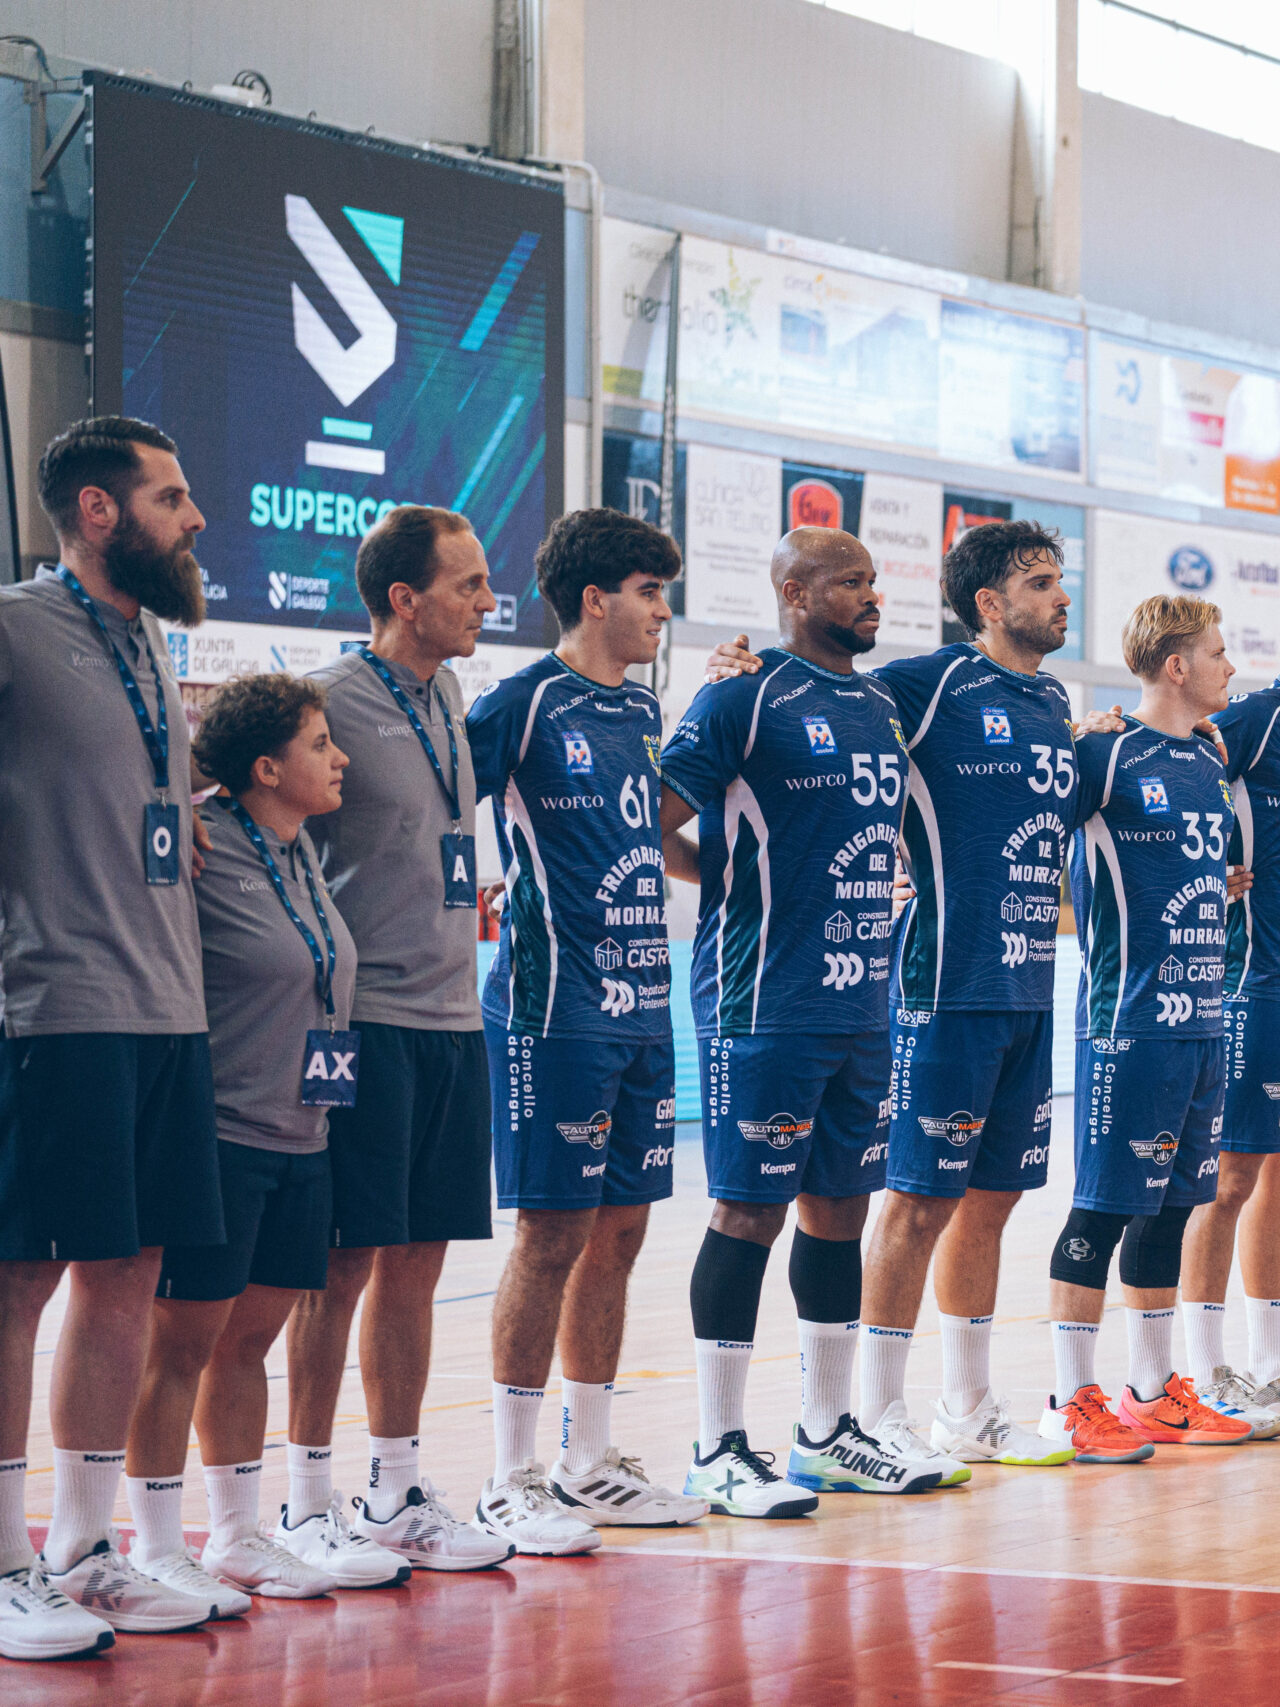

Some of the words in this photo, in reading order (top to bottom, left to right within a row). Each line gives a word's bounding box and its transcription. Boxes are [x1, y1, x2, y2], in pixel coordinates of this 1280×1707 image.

[250, 483, 434, 537] SUPERC
[194, 638, 235, 653] XUNTA
[71, 652, 114, 669] Kemp
[768, 679, 816, 710] VITALDENT
[951, 674, 1001, 697] VITALDEN
[378, 723, 414, 738] Kemp
[1121, 739, 1168, 770] VITALDENT
[1169, 749, 1196, 762] Kempa
[784, 773, 847, 791] WOFCO
[851, 753, 901, 807] 55
[956, 762, 1022, 775] WOFCO
[1027, 744, 1075, 799] 35
[540, 795, 604, 811] WOFCO
[619, 774, 652, 829] 61
[1117, 830, 1176, 842] WOFCO
[1180, 811, 1224, 861] 33
[452, 855, 468, 882] A
[869, 853, 887, 872] DEL
[636, 877, 658, 897] DEL
[1199, 903, 1218, 920] DEL
[507, 1035, 518, 1057] de
[710, 1037, 720, 1057] de
[895, 1035, 904, 1054] de
[1234, 1011, 1248, 1080] Concello
[305, 1051, 356, 1081] AX
[521, 1035, 536, 1119] Concello
[720, 1038, 734, 1115] Concello
[902, 1036, 916, 1110] Concello
[1093, 1062, 1102, 1081] de
[508, 1063, 520, 1132] Cangas
[709, 1063, 719, 1127] Cangas
[891, 1060, 901, 1120] Cangas
[1101, 1063, 1116, 1135] Concello
[1089, 1086, 1101, 1145] Cangas
[582, 1162, 607, 1178] Kemp
[761, 1162, 796, 1176] Kempa
[561, 1407, 573, 1449] Kempa
